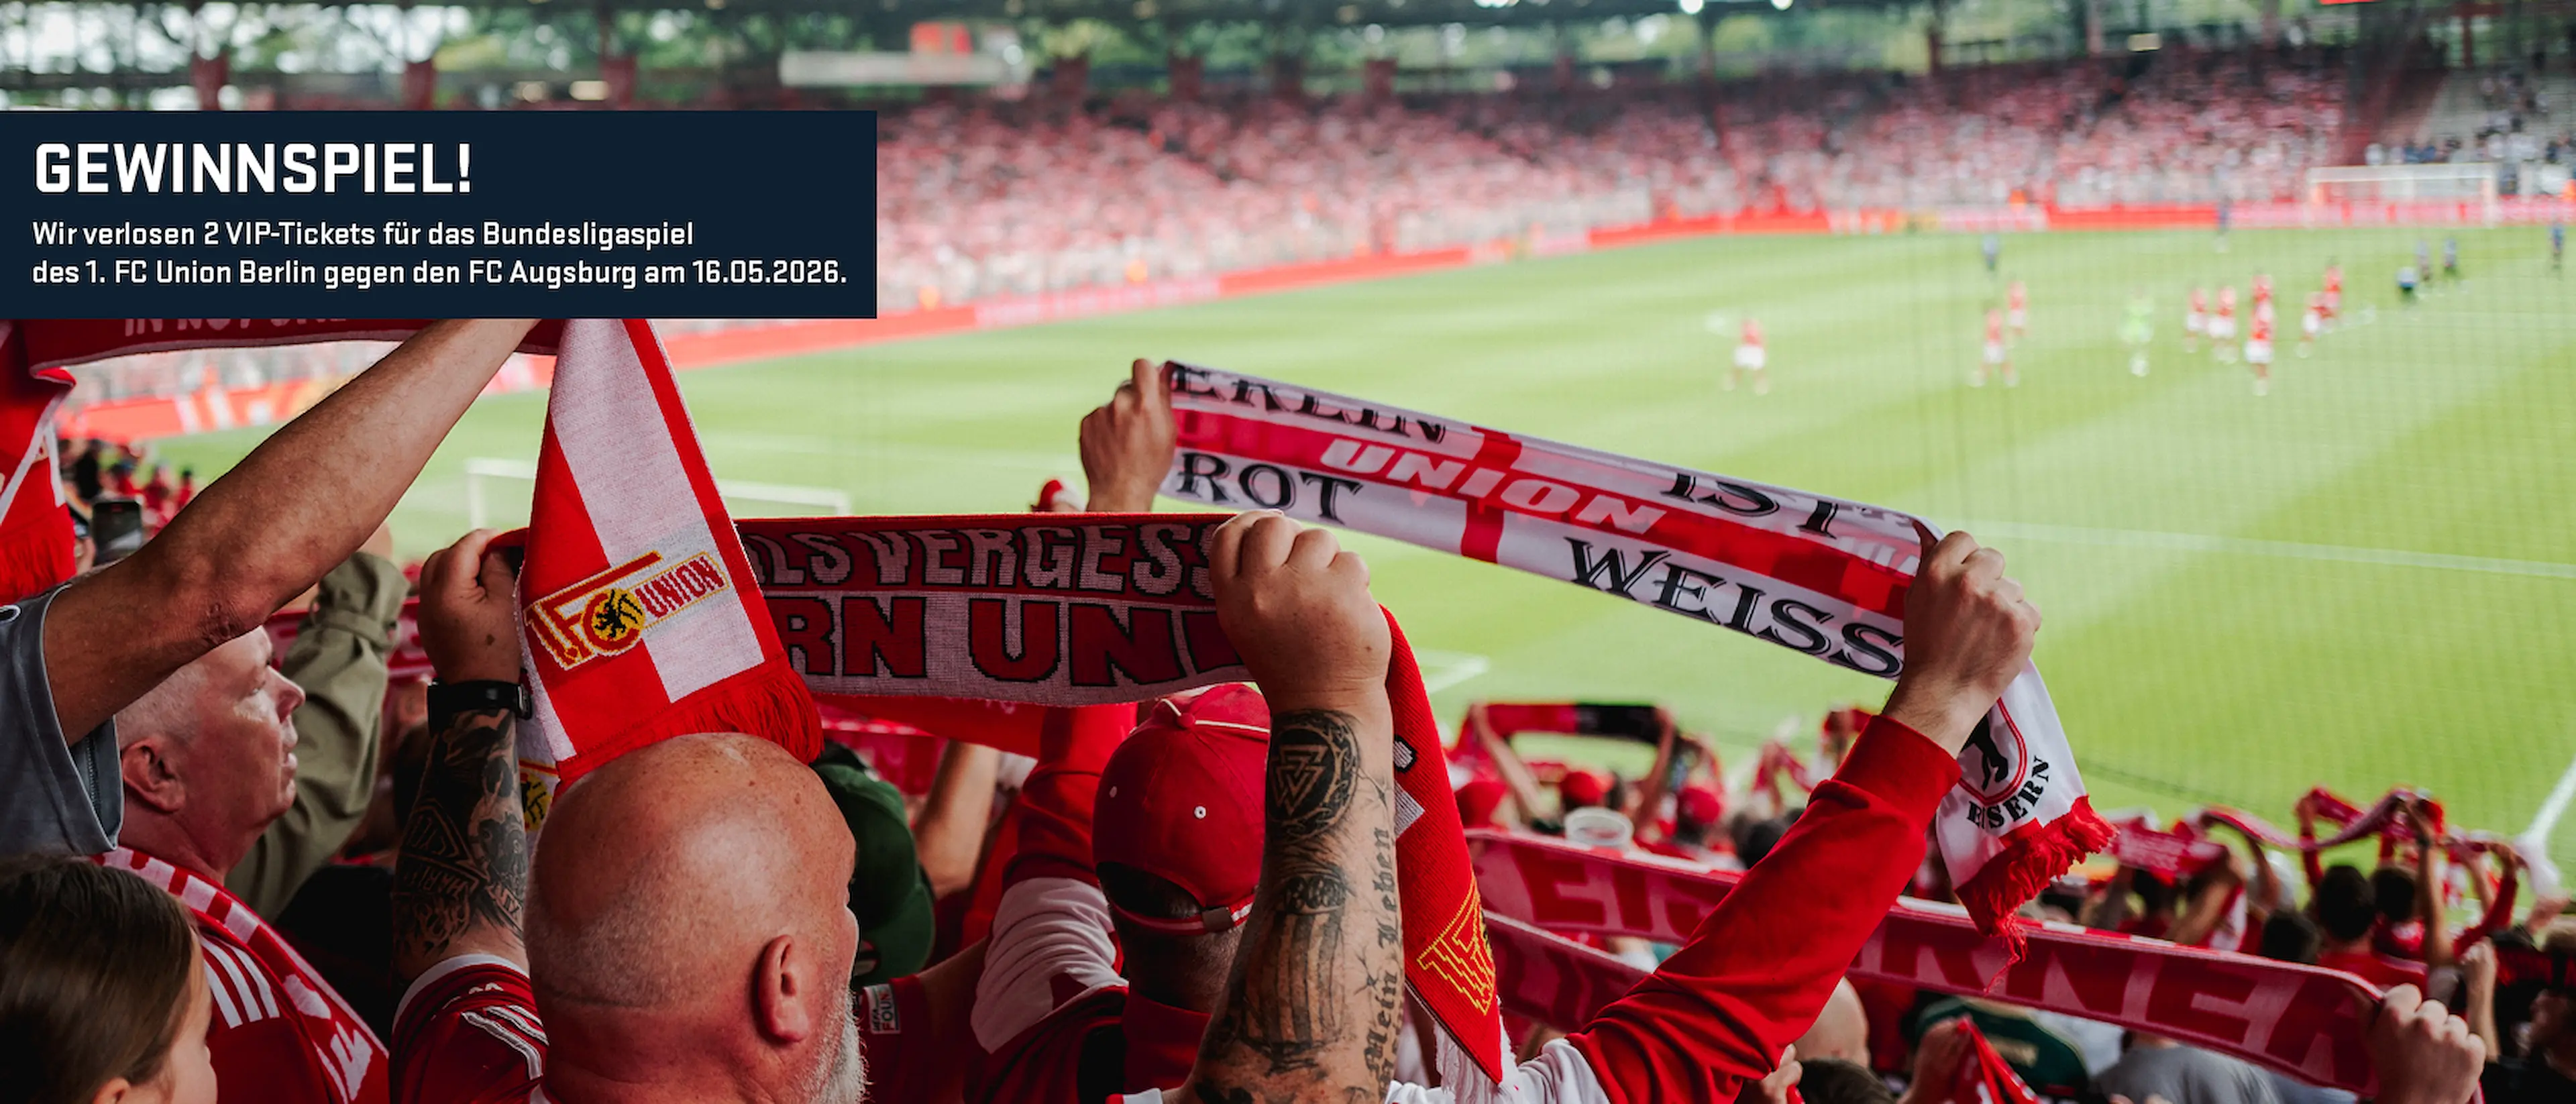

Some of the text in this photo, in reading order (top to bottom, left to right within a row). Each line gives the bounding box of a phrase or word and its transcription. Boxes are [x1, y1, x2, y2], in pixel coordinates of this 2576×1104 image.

[1319, 437, 1668, 535] UNION
[634, 555, 726, 619] UNION
[1175, 451, 1904, 678] ROT WEISS
